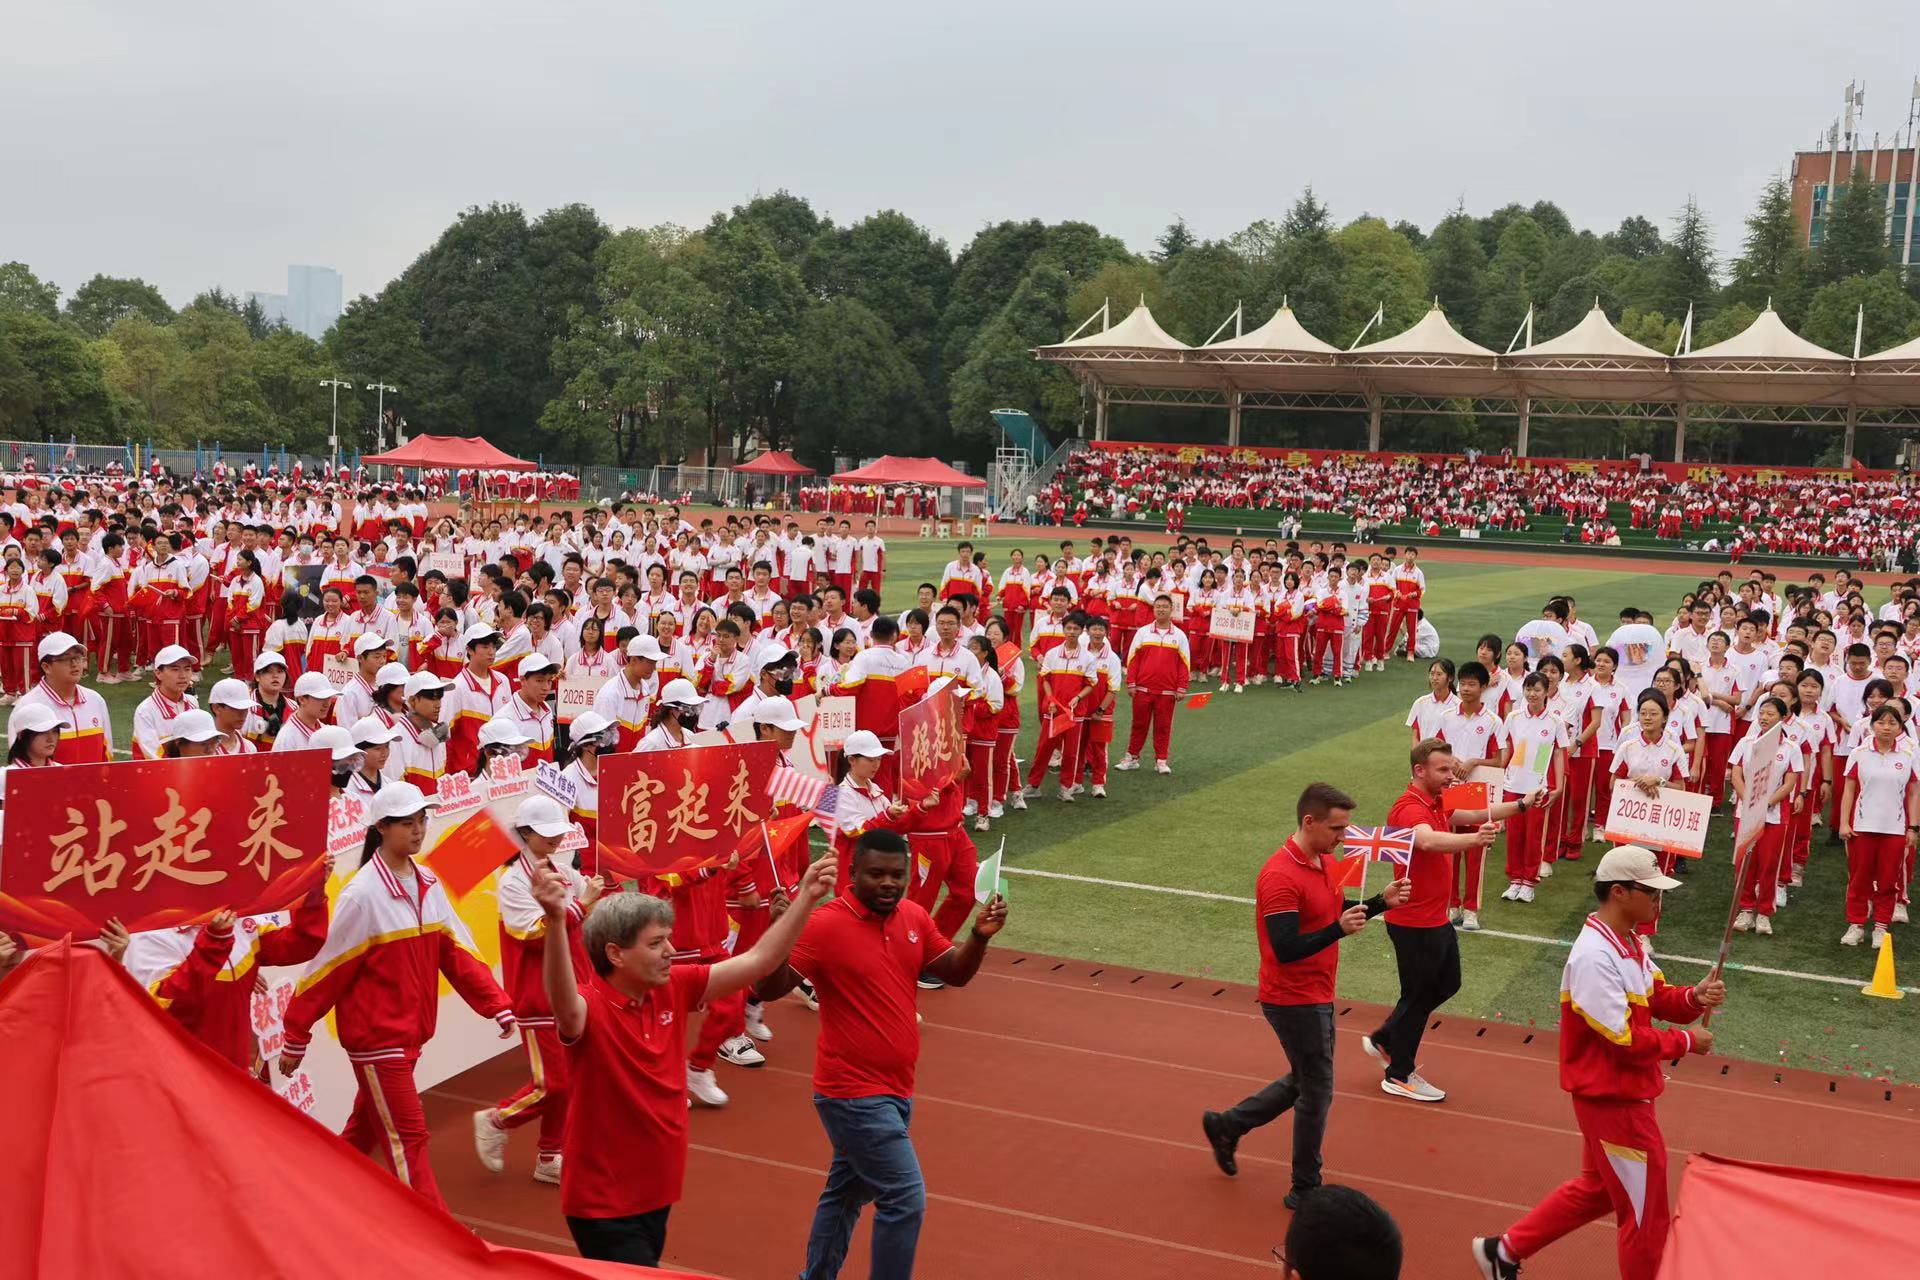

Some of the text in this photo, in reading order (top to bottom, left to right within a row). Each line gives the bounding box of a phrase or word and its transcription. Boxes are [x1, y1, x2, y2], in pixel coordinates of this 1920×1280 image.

[495, 755, 520, 781] 透明
[538, 761, 578, 799] 不可信的
[621, 758, 760, 854] 富起来
[42, 774, 304, 896] 站起来
[283, 1073, 311, 1101] 印象
